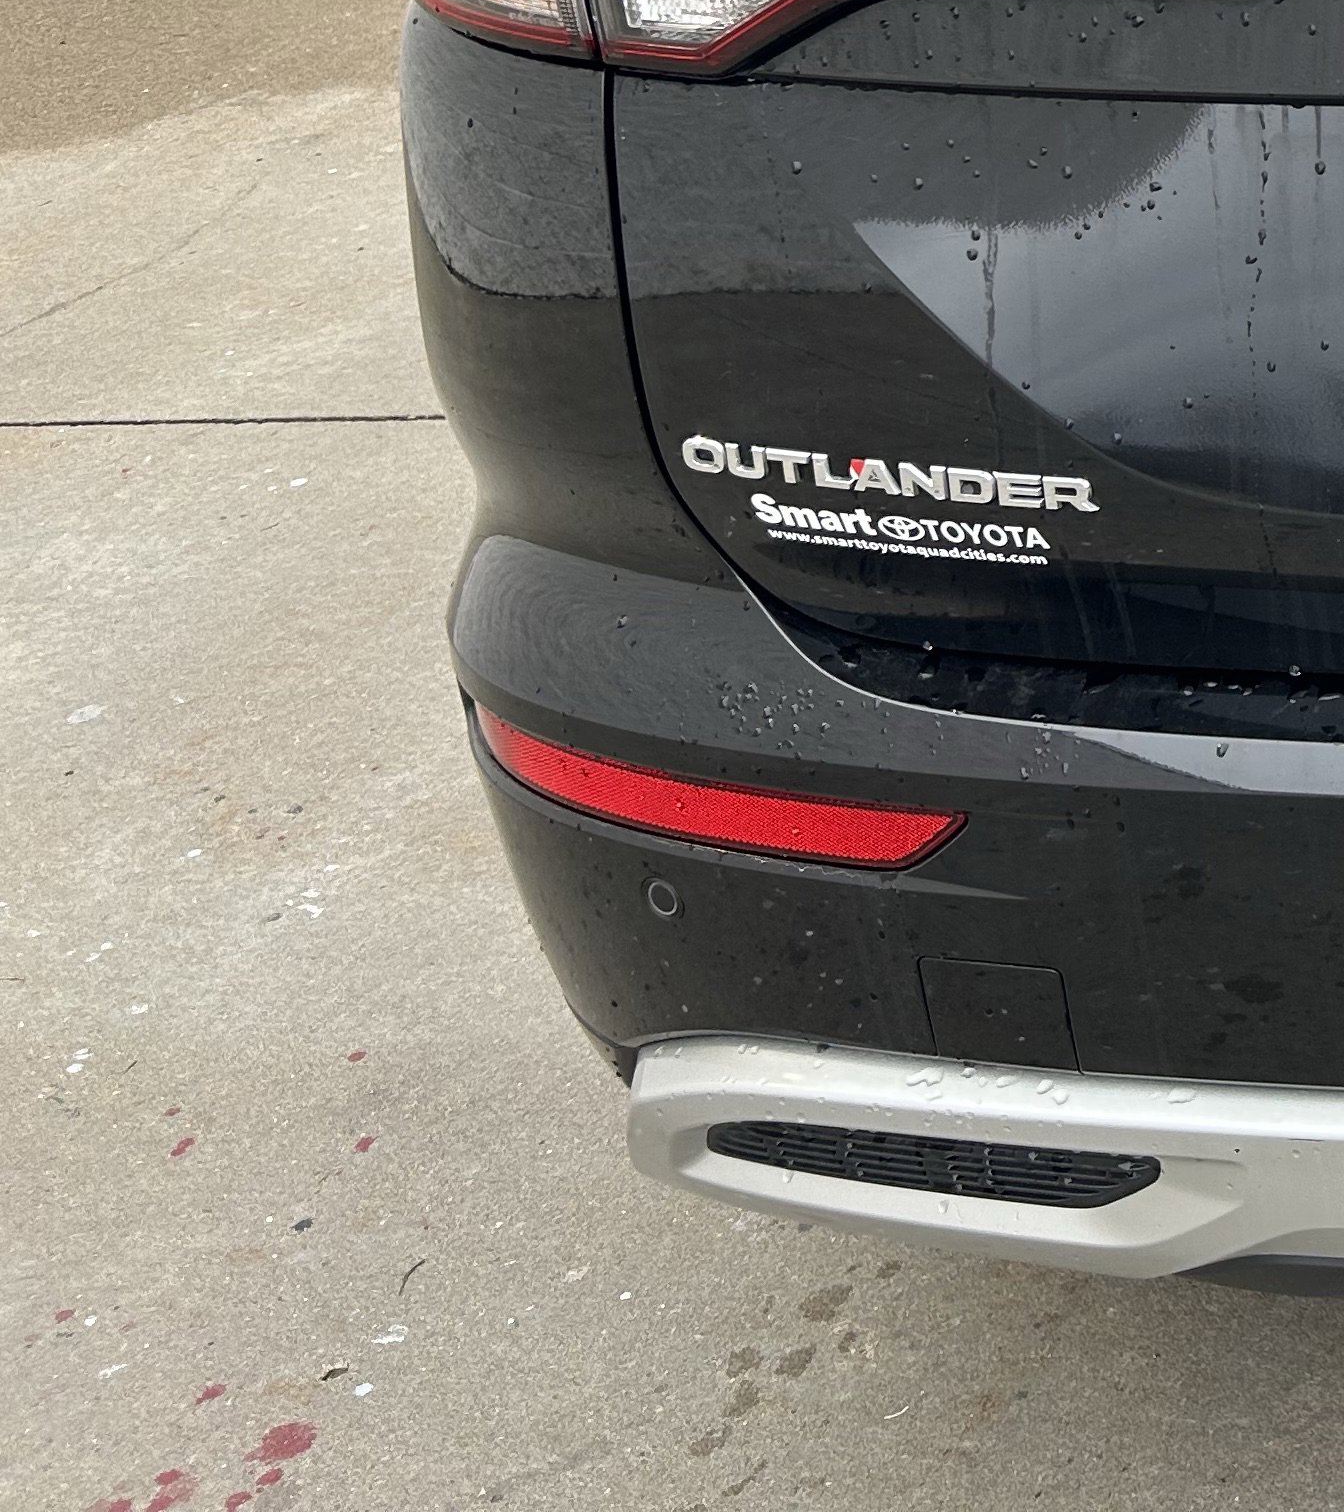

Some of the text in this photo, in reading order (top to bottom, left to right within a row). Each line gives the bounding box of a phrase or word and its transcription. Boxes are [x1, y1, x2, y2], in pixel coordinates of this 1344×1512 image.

[682, 435, 1100, 512] OUTLANDER
[750, 492, 1051, 550] Smart TOYOTA
[766, 527, 1049, 565] www.smarttoyotaquadcities.com
